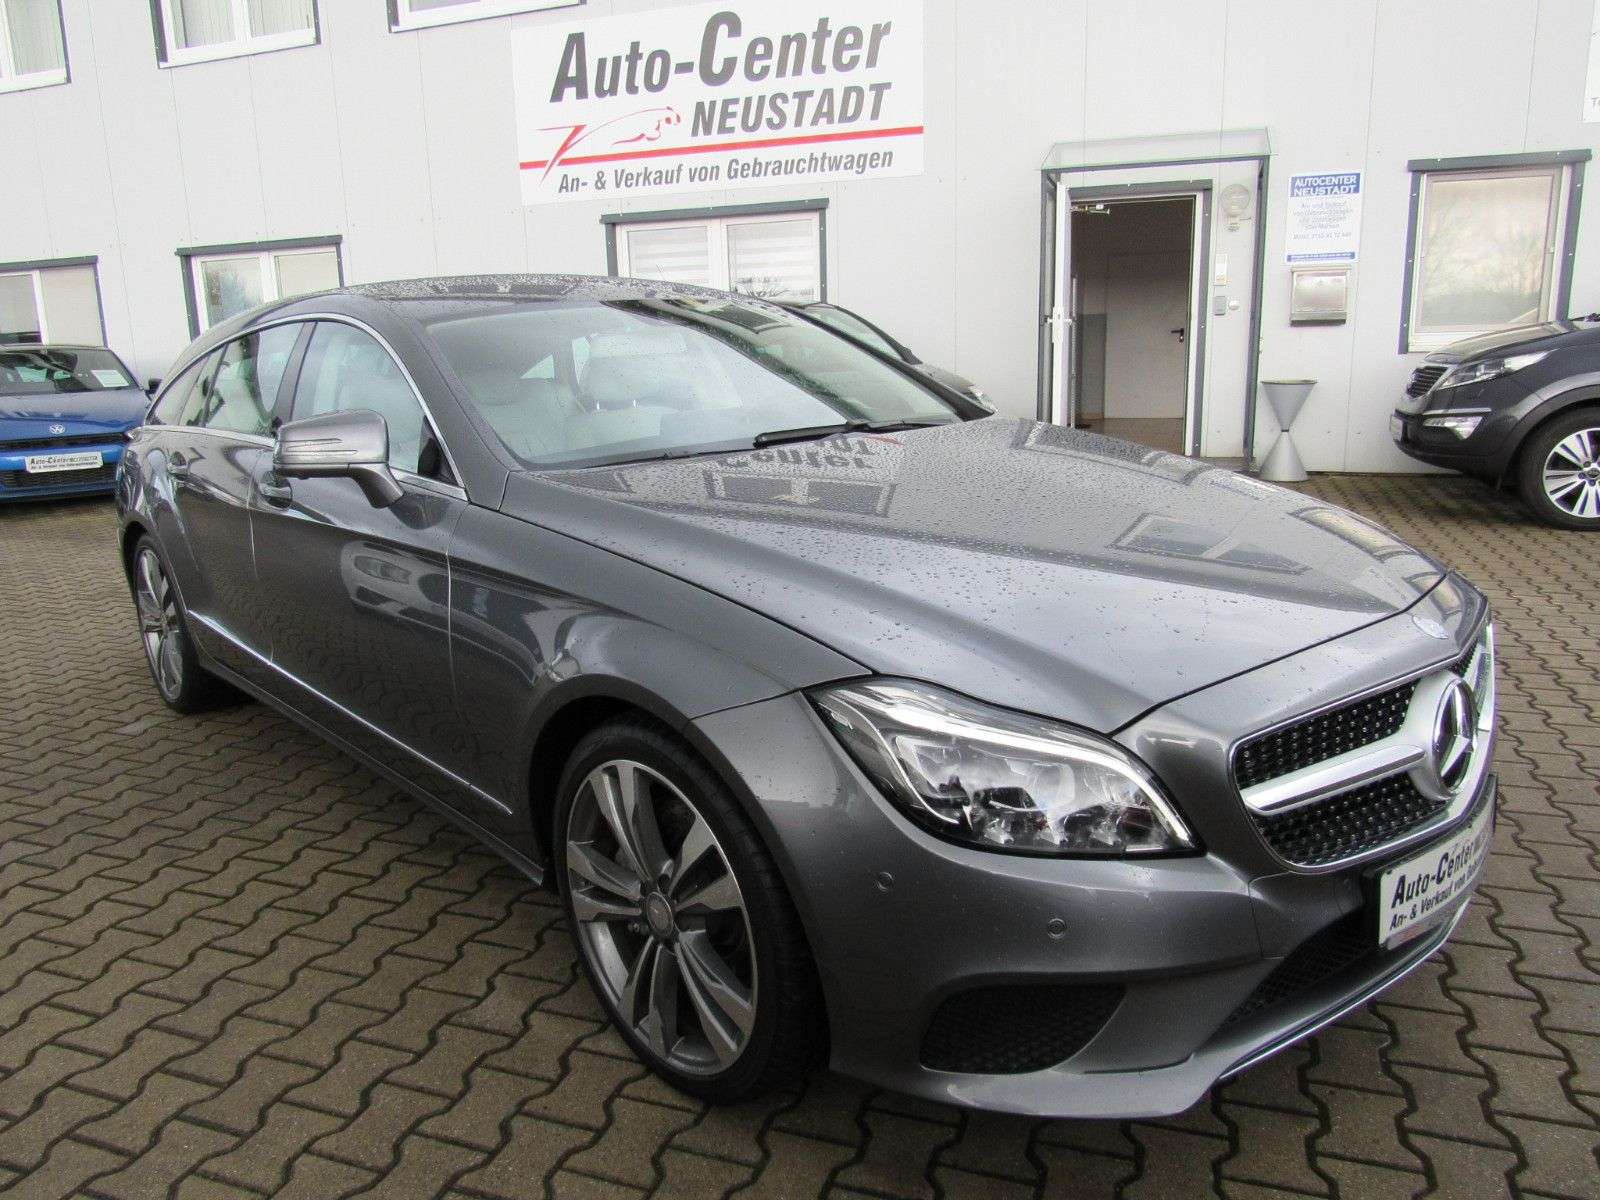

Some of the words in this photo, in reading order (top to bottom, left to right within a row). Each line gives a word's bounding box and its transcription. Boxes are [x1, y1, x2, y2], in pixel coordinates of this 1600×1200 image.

[549, 11, 893, 103] Auto-Center
[691, 82, 892, 138] NEUSTADT
[558, 173, 588, 194] An-
[594, 170, 607, 190] &
[613, 162, 683, 189] Verkauf
[688, 165, 720, 184] von
[727, 149, 894, 181] Gebrauchtwagen
[1294, 175, 1357, 188] AUTOCENTER
[1294, 184, 1357, 196] NEUSTADT
[1409, 903, 1418, 920] &
